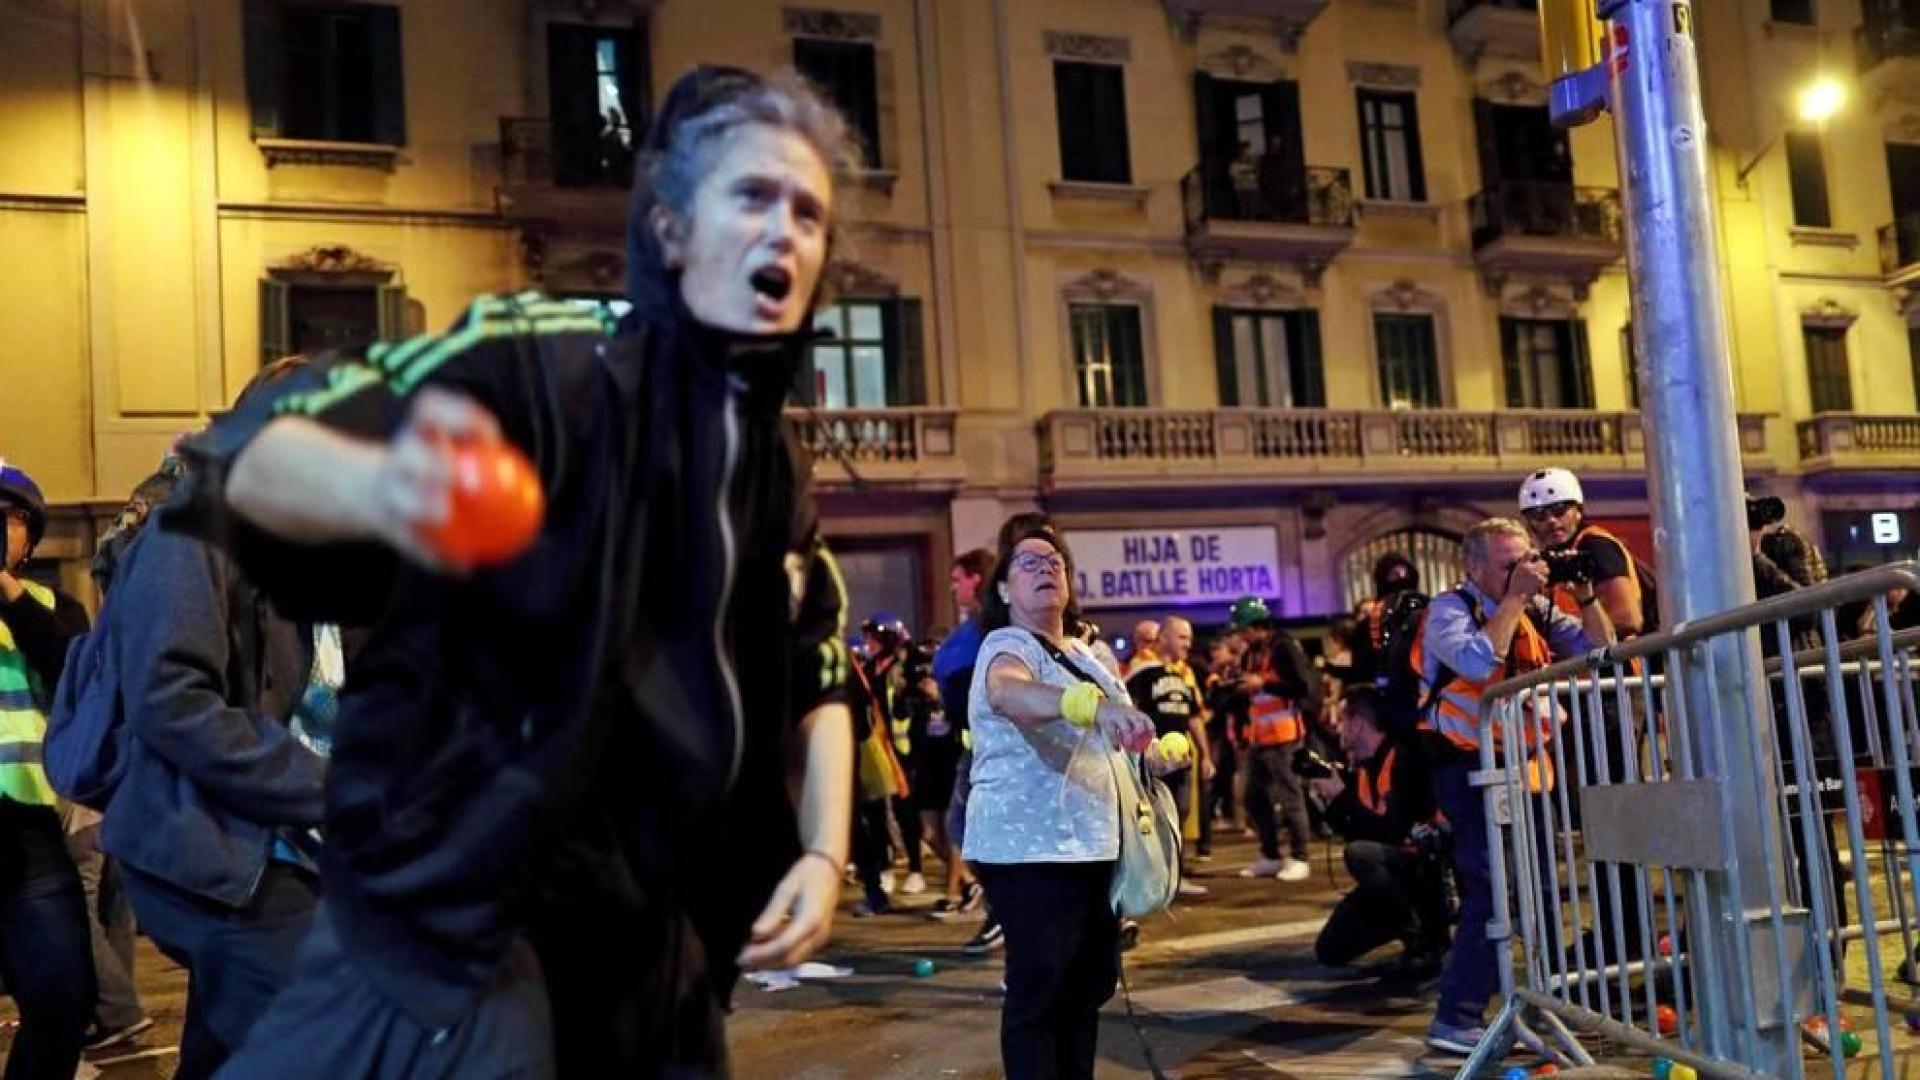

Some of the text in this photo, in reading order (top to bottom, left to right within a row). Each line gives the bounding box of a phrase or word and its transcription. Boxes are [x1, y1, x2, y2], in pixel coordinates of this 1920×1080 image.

[1122, 535, 1221, 563] HIJA DE
[1077, 564, 1273, 598] J. BATLLE HORTA
